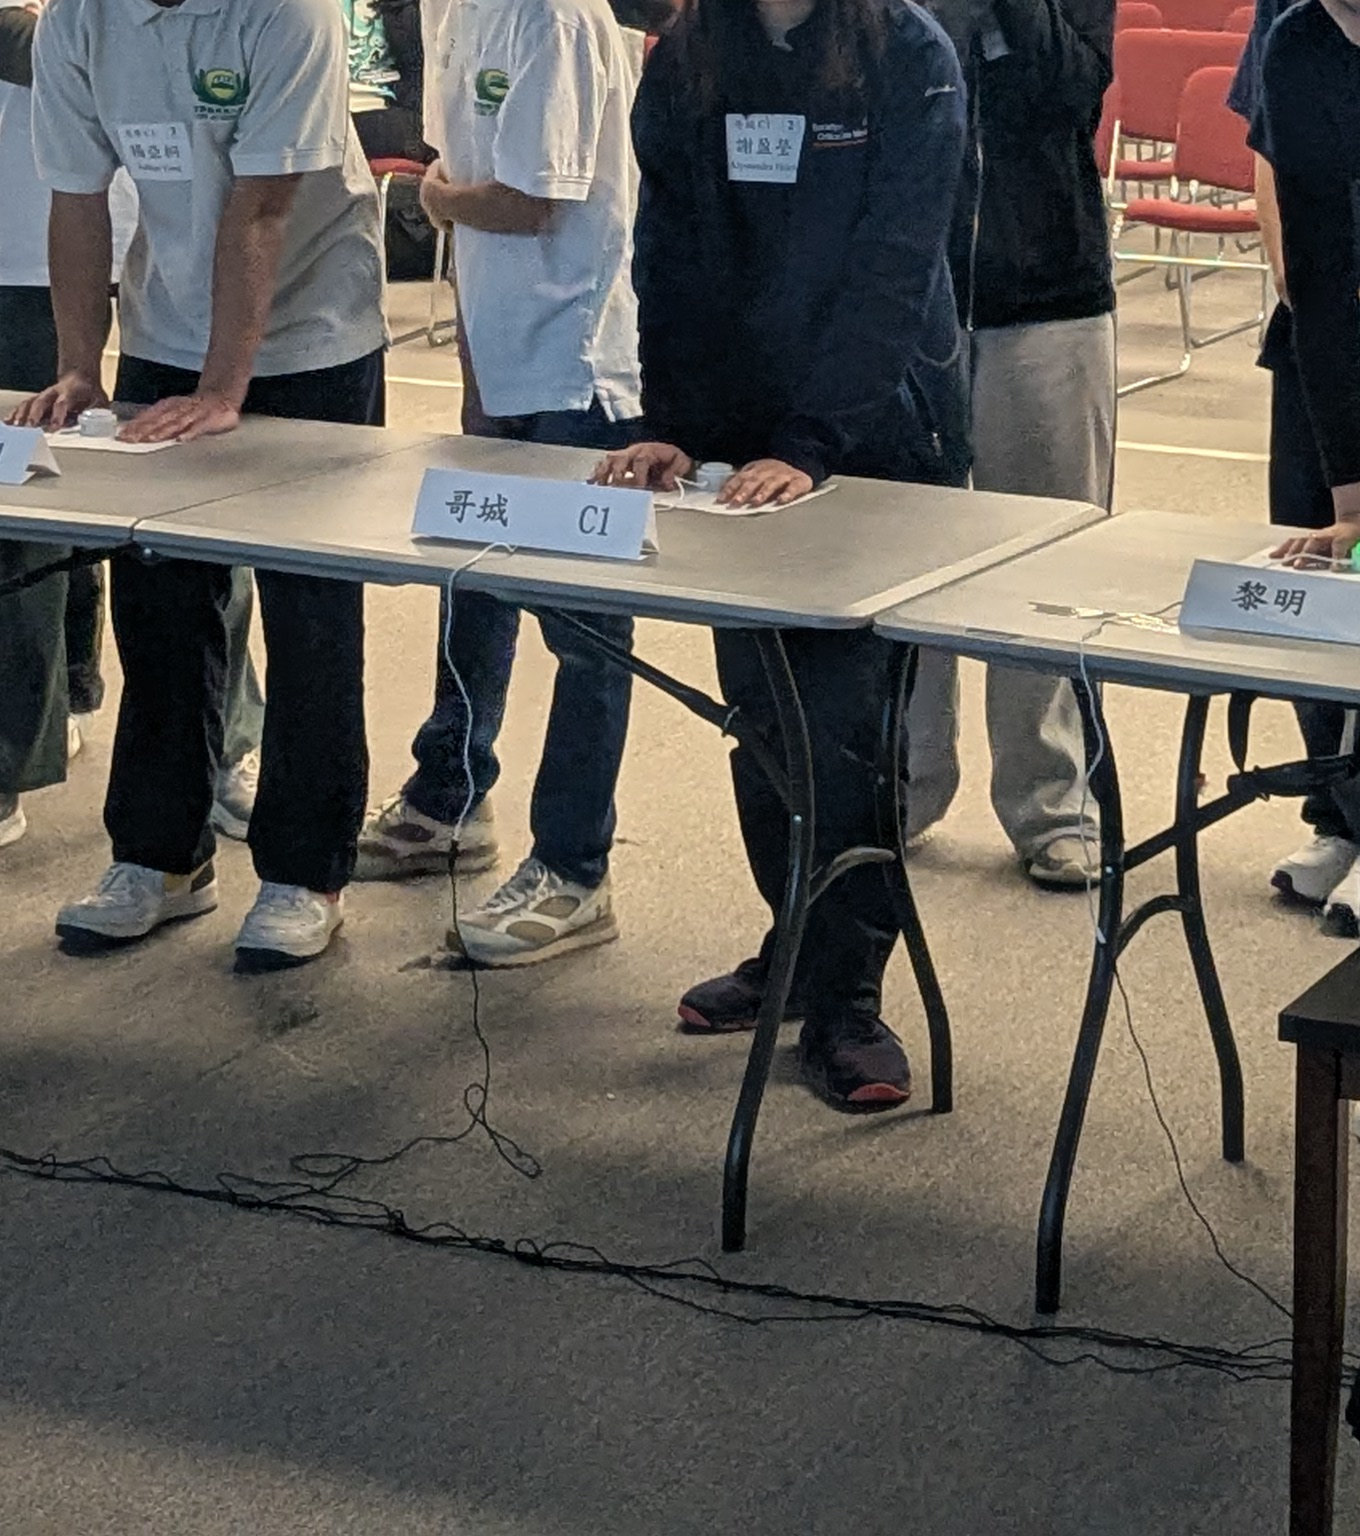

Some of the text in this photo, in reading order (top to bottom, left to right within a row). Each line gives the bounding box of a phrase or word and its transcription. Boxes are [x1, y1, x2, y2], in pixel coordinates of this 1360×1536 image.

[445, 490, 610, 536] 哥城 C1
[1231, 580, 1307, 617] 黎明
